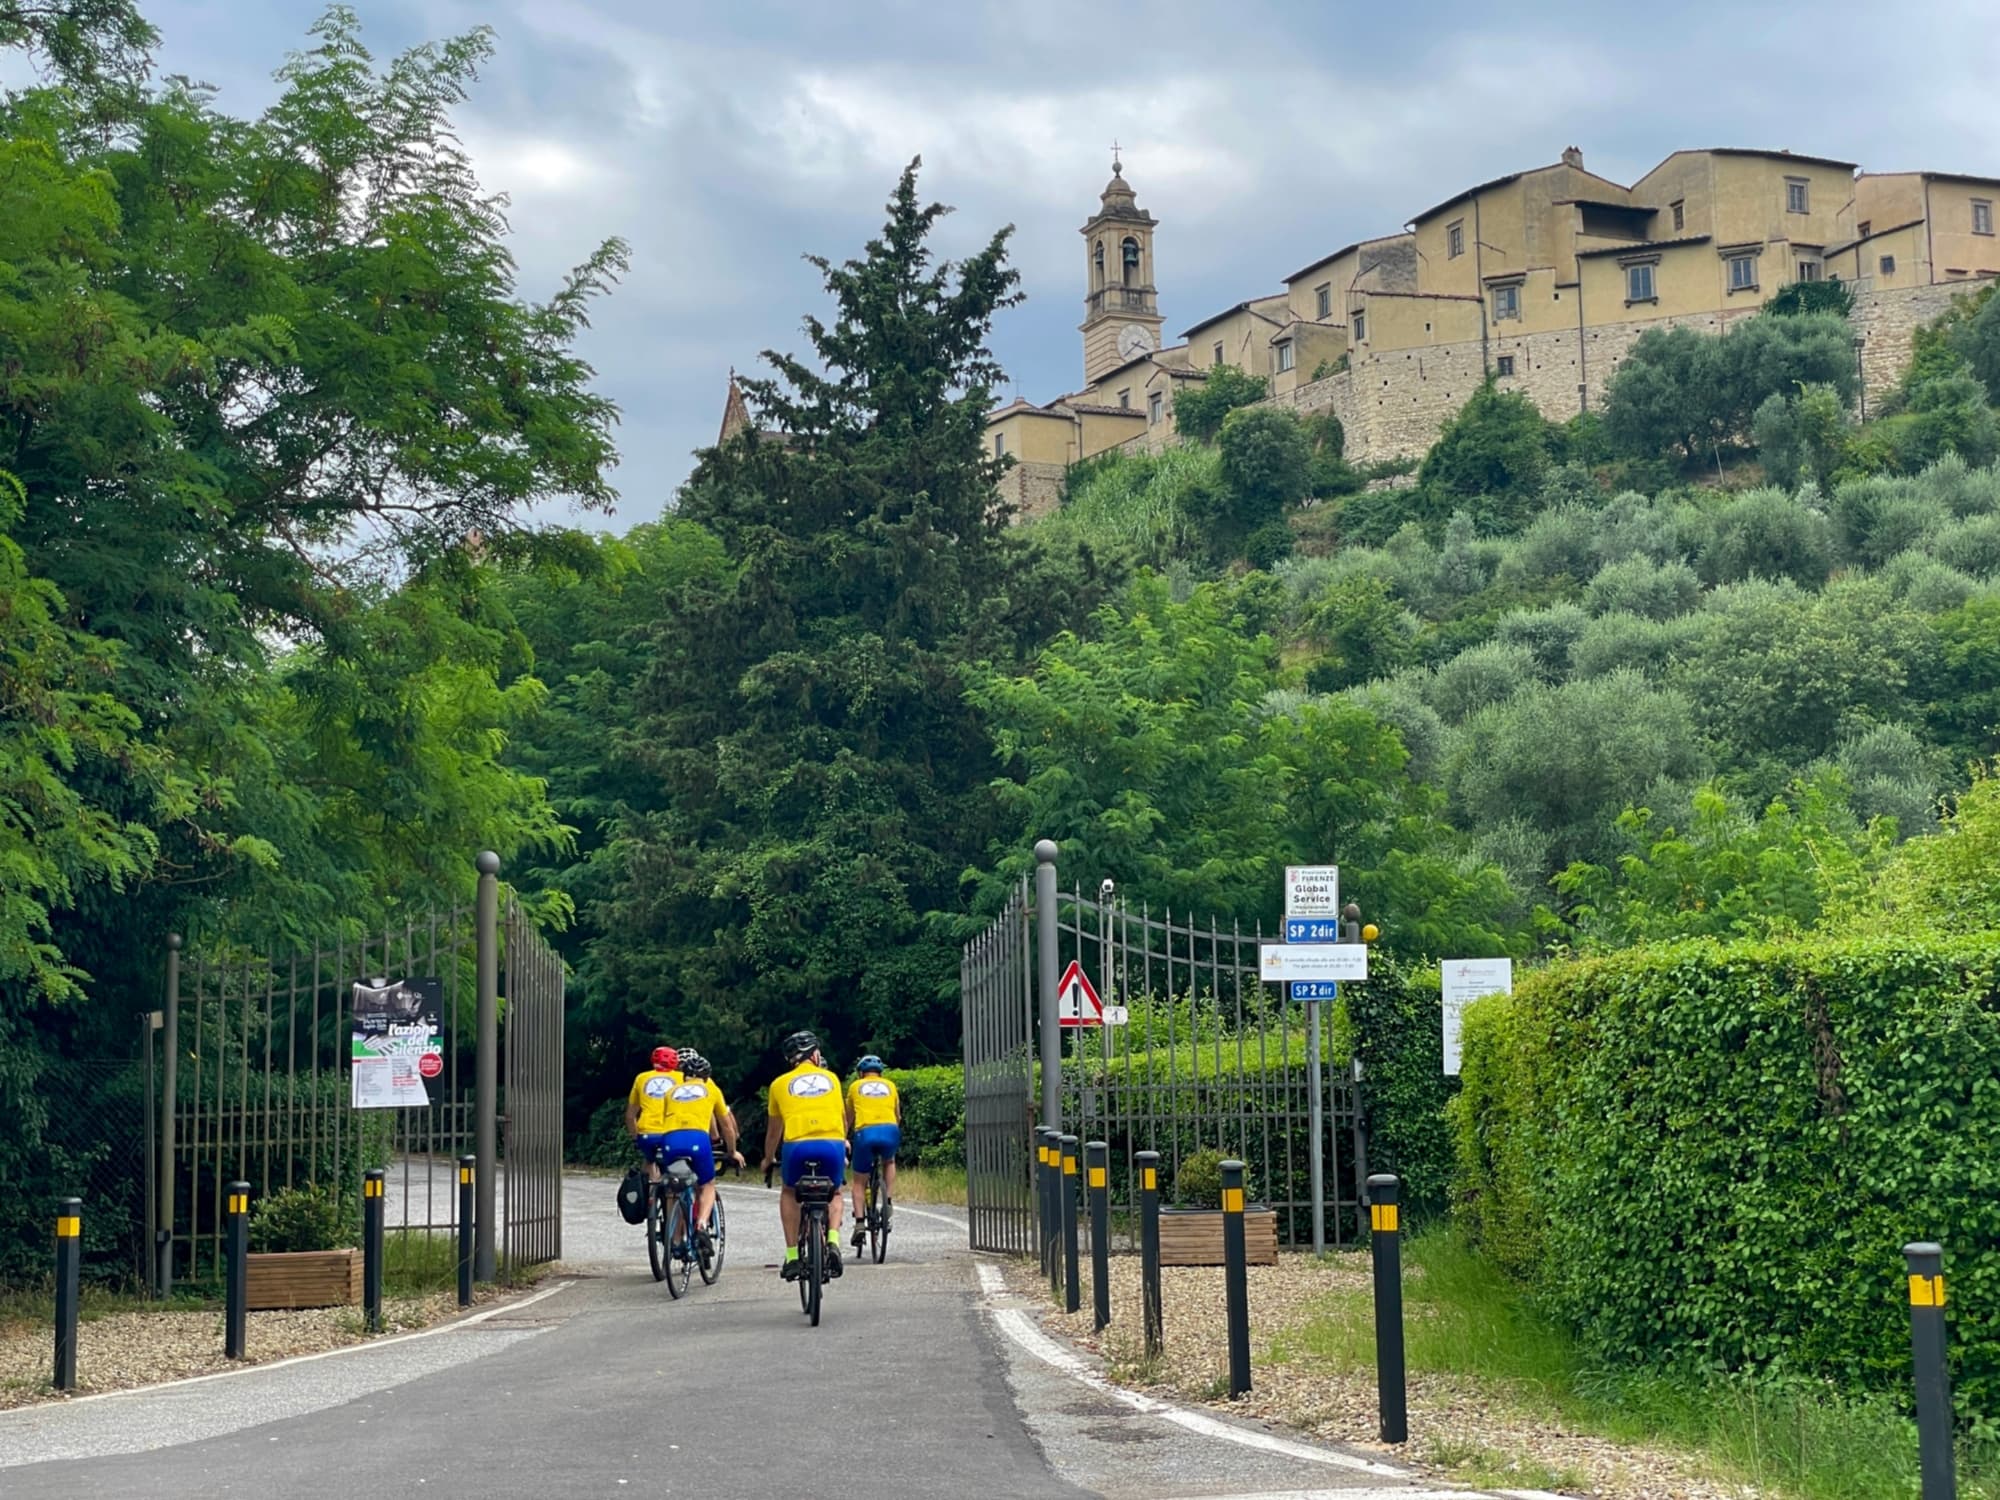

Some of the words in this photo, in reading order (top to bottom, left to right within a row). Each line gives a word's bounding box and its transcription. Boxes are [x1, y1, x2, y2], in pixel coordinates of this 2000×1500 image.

[1295, 884, 1328, 893] Global
[1293, 894, 1331, 903] Service
[1289, 924, 1305, 937] SP
[1295, 985, 1308, 996] SP
[1310, 984, 1317, 996] 2
[1318, 985, 1332, 996] dir
[388, 1022, 438, 1036] l'azione
[391, 1042, 441, 1056] silenzio
